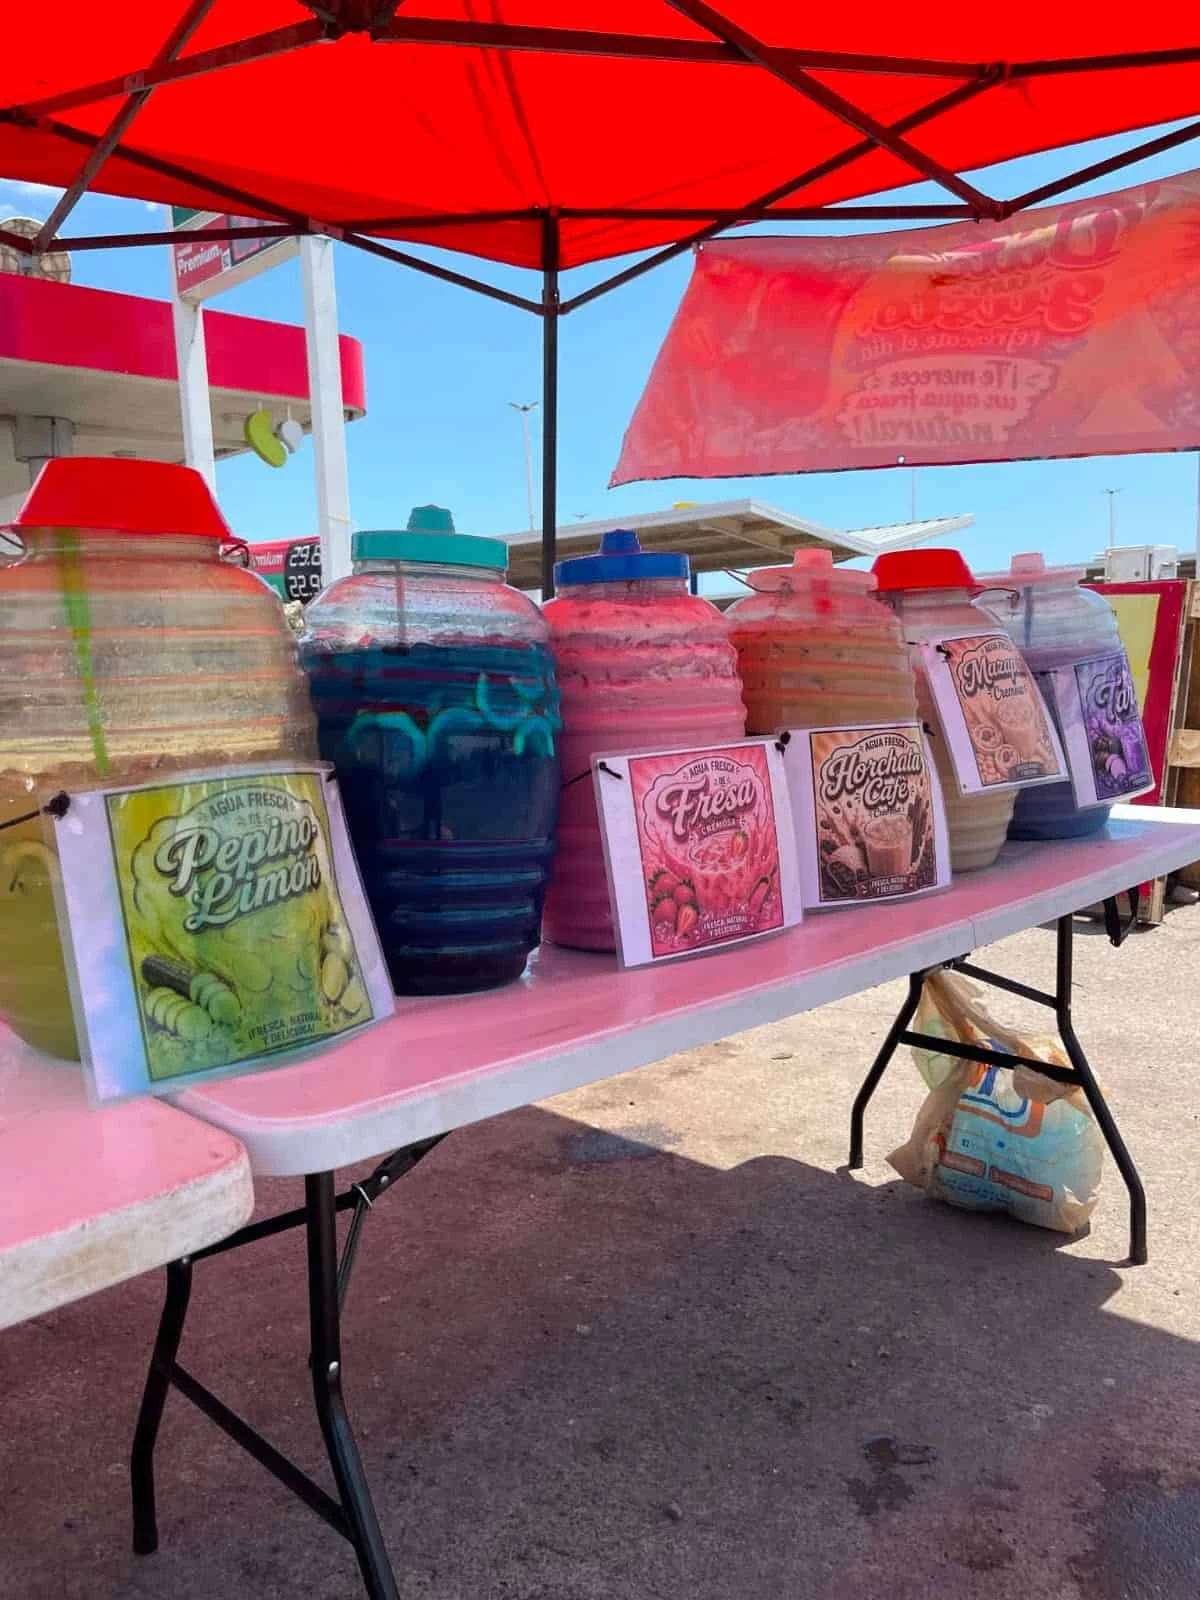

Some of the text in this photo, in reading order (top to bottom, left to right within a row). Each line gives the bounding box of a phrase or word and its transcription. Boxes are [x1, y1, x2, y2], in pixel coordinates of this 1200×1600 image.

[177, 245, 221, 278] Premium
[865, 737, 905, 751] AGUA FRESCA
[689, 760, 736, 778] AGUA FRESCA
[824, 747, 924, 801] Horchata
[208, 791, 290, 818] AGUA FRESCA
[656, 775, 756, 842] Fresa
[153, 815, 319, 897] Pepino
[183, 850, 321, 933] Limón
